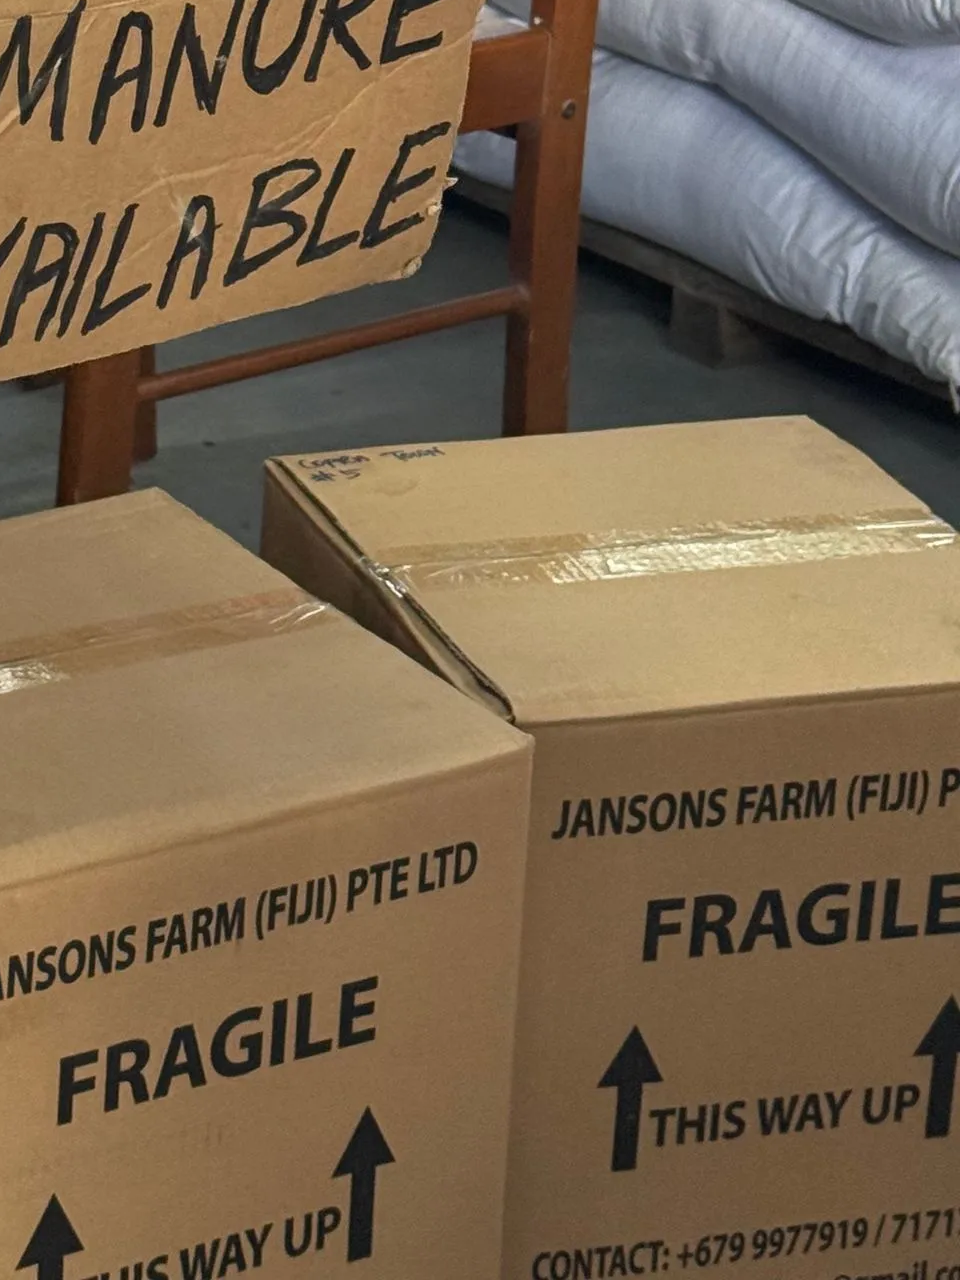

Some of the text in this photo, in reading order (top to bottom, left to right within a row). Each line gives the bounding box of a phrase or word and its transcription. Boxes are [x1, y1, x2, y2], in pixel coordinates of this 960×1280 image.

[551, 788, 728, 840] JANSONS
[736, 778, 837, 825] FARM
[847, 770, 929, 820] (FIJI)
[145, 897, 246, 963] FARM
[256, 874, 337, 940] (FIJI)
[345, 856, 410, 912] PTE
[418, 841, 478, 894] LTD
[642, 872, 960, 962] FRAGILE
[57, 976, 379, 1126] FRAGILE
[649, 1084, 920, 1147] THIS WAY UP
[179, 1222, 274, 1280] WAY
[284, 1206, 342, 1258] UP
[532, 1207, 960, 1280] CONTACT: +679 9977919 / 7171
